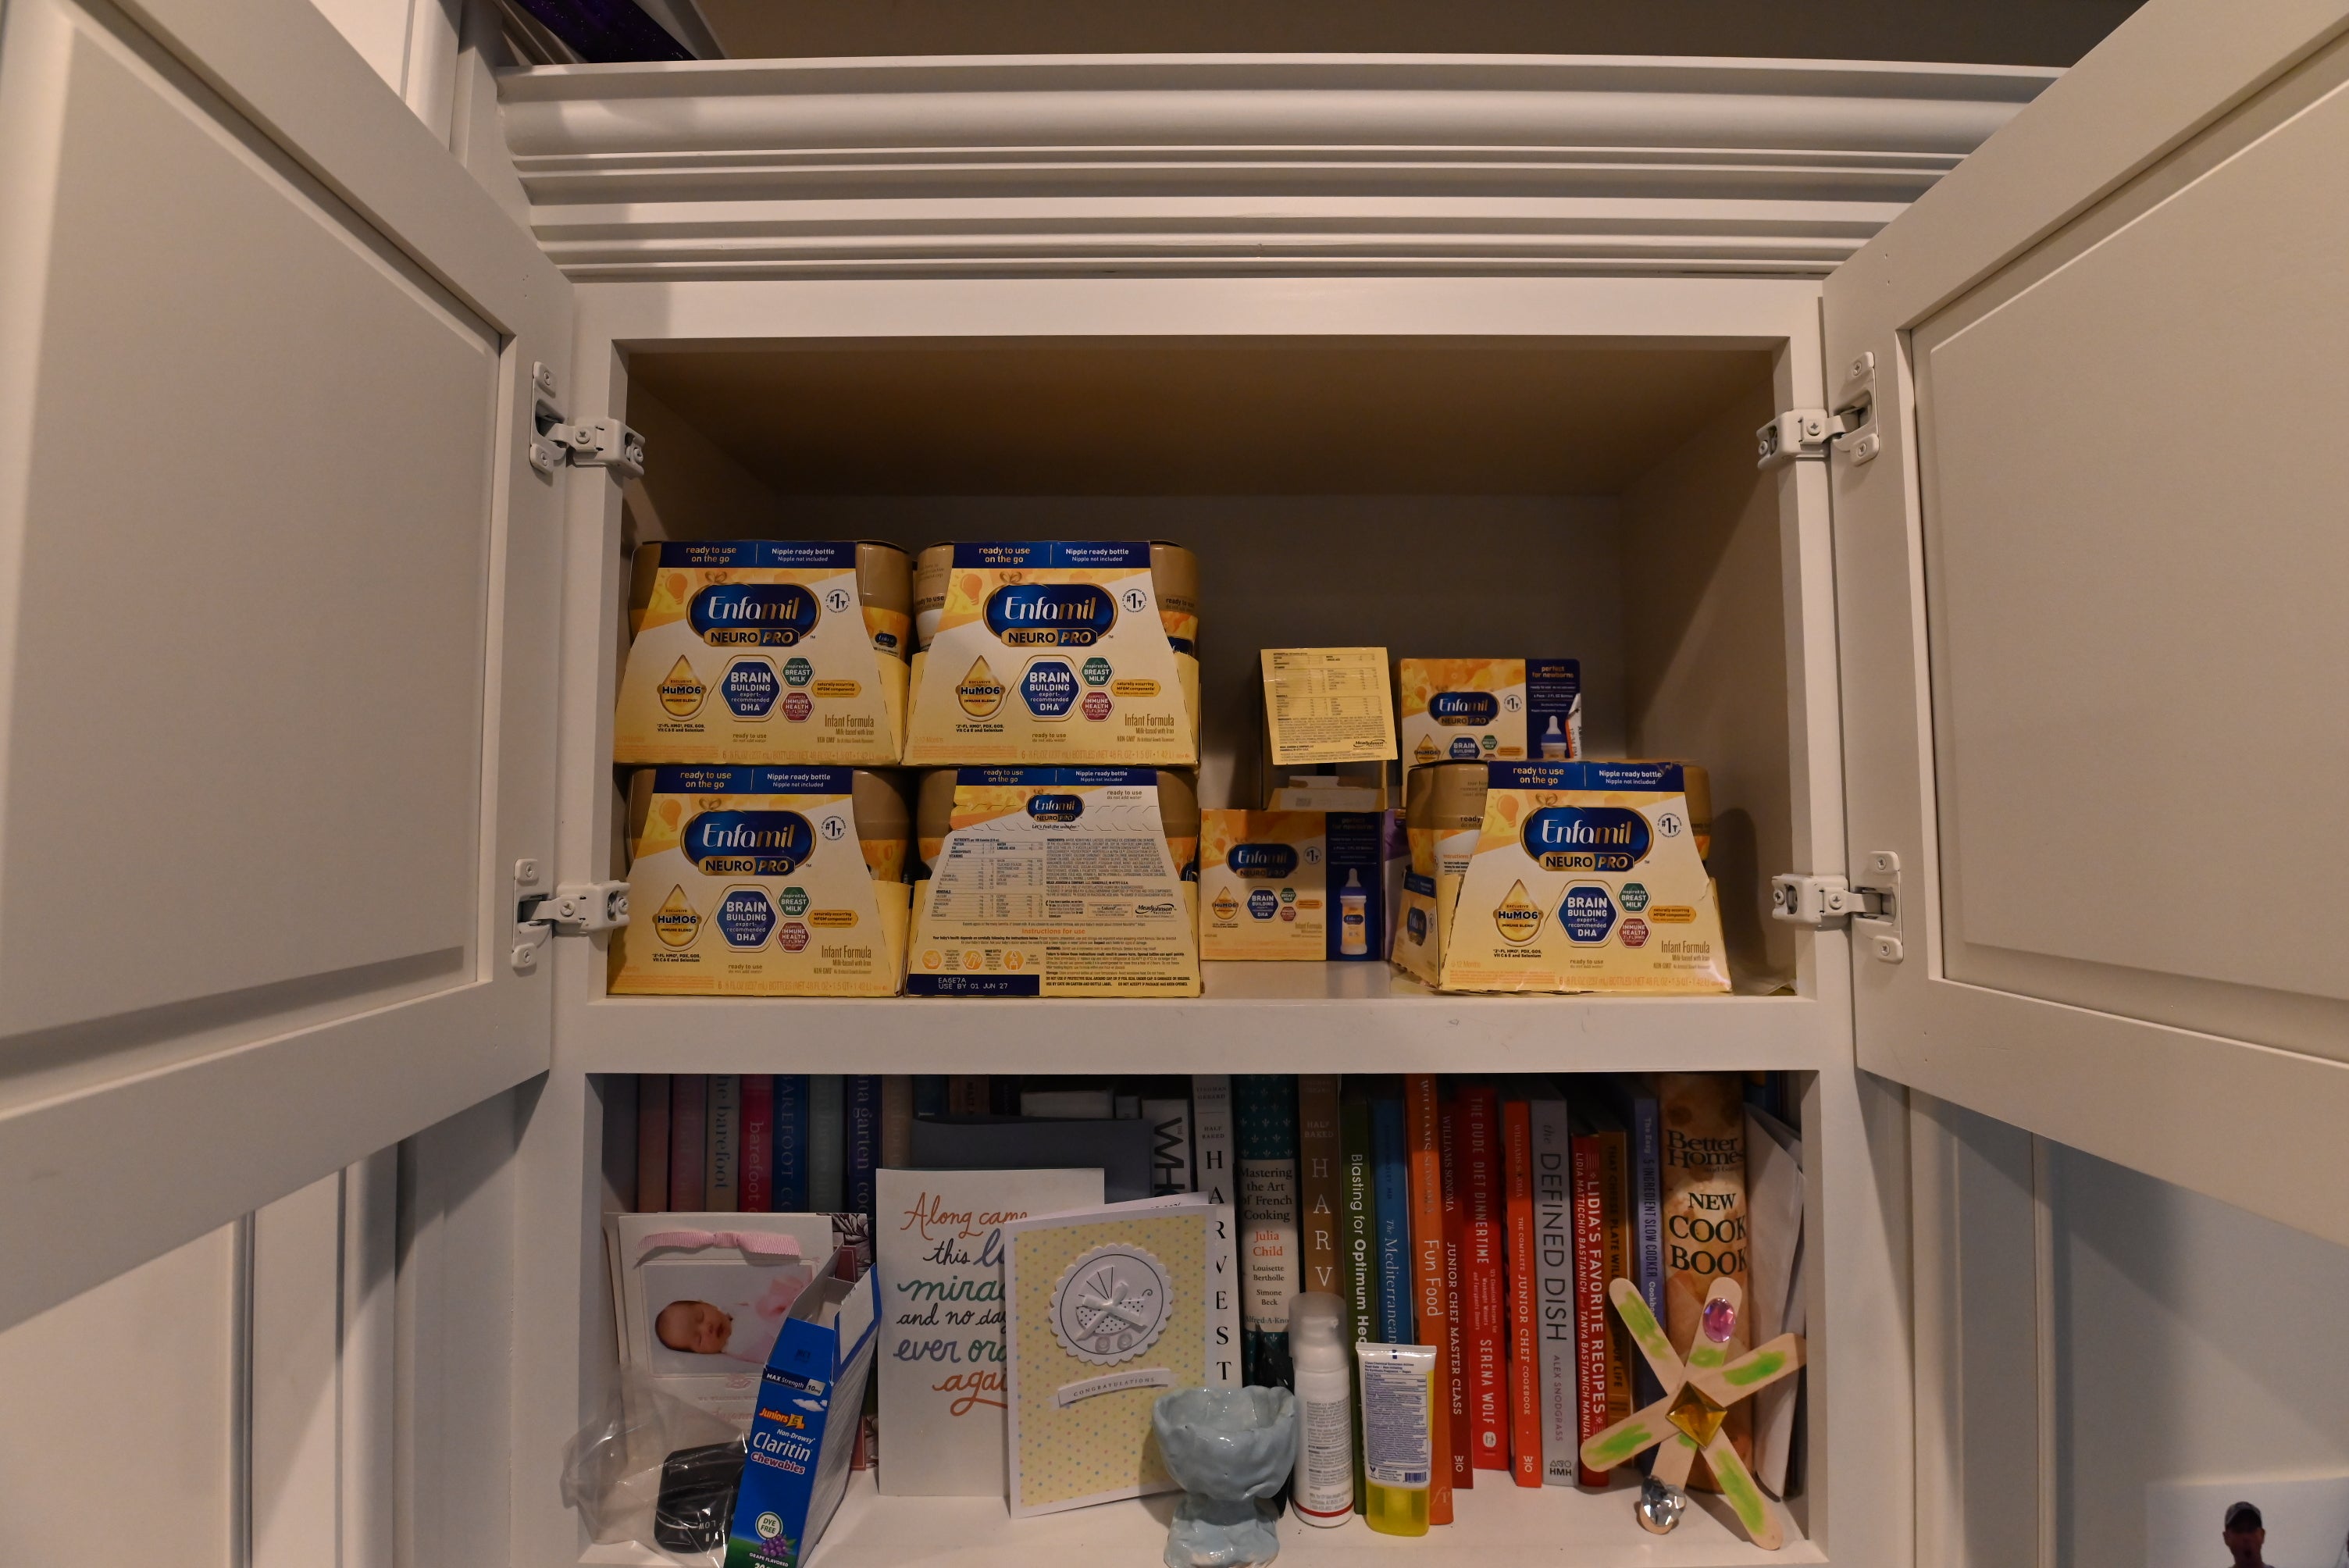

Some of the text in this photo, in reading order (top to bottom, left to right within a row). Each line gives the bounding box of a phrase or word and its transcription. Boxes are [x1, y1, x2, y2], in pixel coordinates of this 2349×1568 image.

[708, 597, 800, 620] Enfamil
[1004, 597, 1096, 620] Enfamil
[711, 631, 794, 643] NEURO PRO
[1008, 631, 1092, 643] NEURO PRO
[731, 672, 771, 682] BRAIN
[1029, 672, 1070, 682] BRAIN
[1438, 698, 1488, 712] Enfamil
[825, 715, 874, 727] Infant Formula
[1035, 800, 1075, 811] Enfamil
[703, 823, 795, 847] Enfamil
[1542, 820, 1631, 843] Enfamil
[705, 860, 789, 871] NEURO PRO
[1239, 850, 1287, 864] Enfamil
[1546, 856, 1627, 868] NEURO PRO
[1568, 897, 1607, 908] BRAIN
[822, 946, 872, 958] Infant Formula
[1470, 1096, 1484, 1118] THE
[781, 1074, 794, 1179] BAREFOOT
[852, 1107, 872, 1170] garten
[1472, 1123, 1485, 1153] DUDE
[715, 1107, 731, 1189] barefoot
[1666, 1129, 1738, 1152] Better
[747, 1121, 765, 1202] barefoot
[1666, 1148, 1745, 1169] Homes
[1240, 1168, 1292, 1179] Mastering
[1350, 1154, 1363, 1211] Blasting
[1473, 1161, 1487, 1192] DIET
[1247, 1182, 1285, 1191] the Art
[1445, 1168, 1455, 1212] SONOMA
[1643, 1168, 1656, 1217] INGREDIENT
[1243, 1195, 1292, 1205] of French
[1541, 1153, 1565, 1267] DEFINED
[1688, 1192, 1737, 1210] NEW
[900, 1192, 983, 1240] Along
[1244, 1210, 1290, 1223] Cooking
[1353, 1215, 1365, 1235] for
[1474, 1193, 1488, 1263] DINNERTIME
[1254, 1231, 1279, 1242] Julia
[1609, 1219, 1620, 1251] PLATE
[1645, 1220, 1656, 1245] SLOW
[1669, 1215, 1746, 1243] COOK
[923, 1238, 970, 1265] this
[1253, 1246, 1283, 1256] Child
[1646, 1245, 1658, 1278] COOKER
[1670, 1244, 1747, 1274] BOOK
[1353, 1238, 1367, 1310] Optimum
[1447, 1242, 1457, 1288] JUNIOR
[1385, 1238, 1399, 1345] Mediterranean
[1424, 1239, 1443, 1321] Fun Food
[1449, 1293, 1459, 1323] CHEF
[1518, 1274, 1529, 1323] JUNIOR
[1545, 1278, 1567, 1340] DISH
[1574, 1153, 1591, 1441] LIDIA MATTICCHIO BASTIANICH TANYA BASTIANICH MANUAL
[1587, 1181, 1607, 1415] LIDIA'S FAVORITE RECIPES
[896, 1303, 939, 1326] and
[945, 1310, 975, 1326] no
[893, 1338, 962, 1362] ever
[1450, 1327, 1461, 1374] MASTER
[1520, 1328, 1531, 1362] CHEF
[1480, 1339, 1493, 1386] SERENA
[1553, 1355, 1562, 1379] ALEX
[767, 1373, 781, 1382] MAX
[781, 1377, 804, 1388] Strength
[1073, 1377, 1156, 1397] CONGRATULATIONS
[1613, 1366, 1623, 1387] LIFE
[1452, 1379, 1462, 1415] CLASS
[1482, 1392, 1495, 1424] WOLF
[759, 1407, 789, 1423] Juniors
[1554, 1383, 1564, 1441] SNODGRASS
[753, 1431, 811, 1462] Claritin
[750, 1451, 806, 1474] Chewables
[1549, 1467, 1571, 1476] HMH
[761, 1524, 776, 1534] FREE
[763, 1518, 776, 1527] DYE
[750, 1552, 766, 1562] GRAPE
[765, 1557, 789, 1567] FLAVORED
